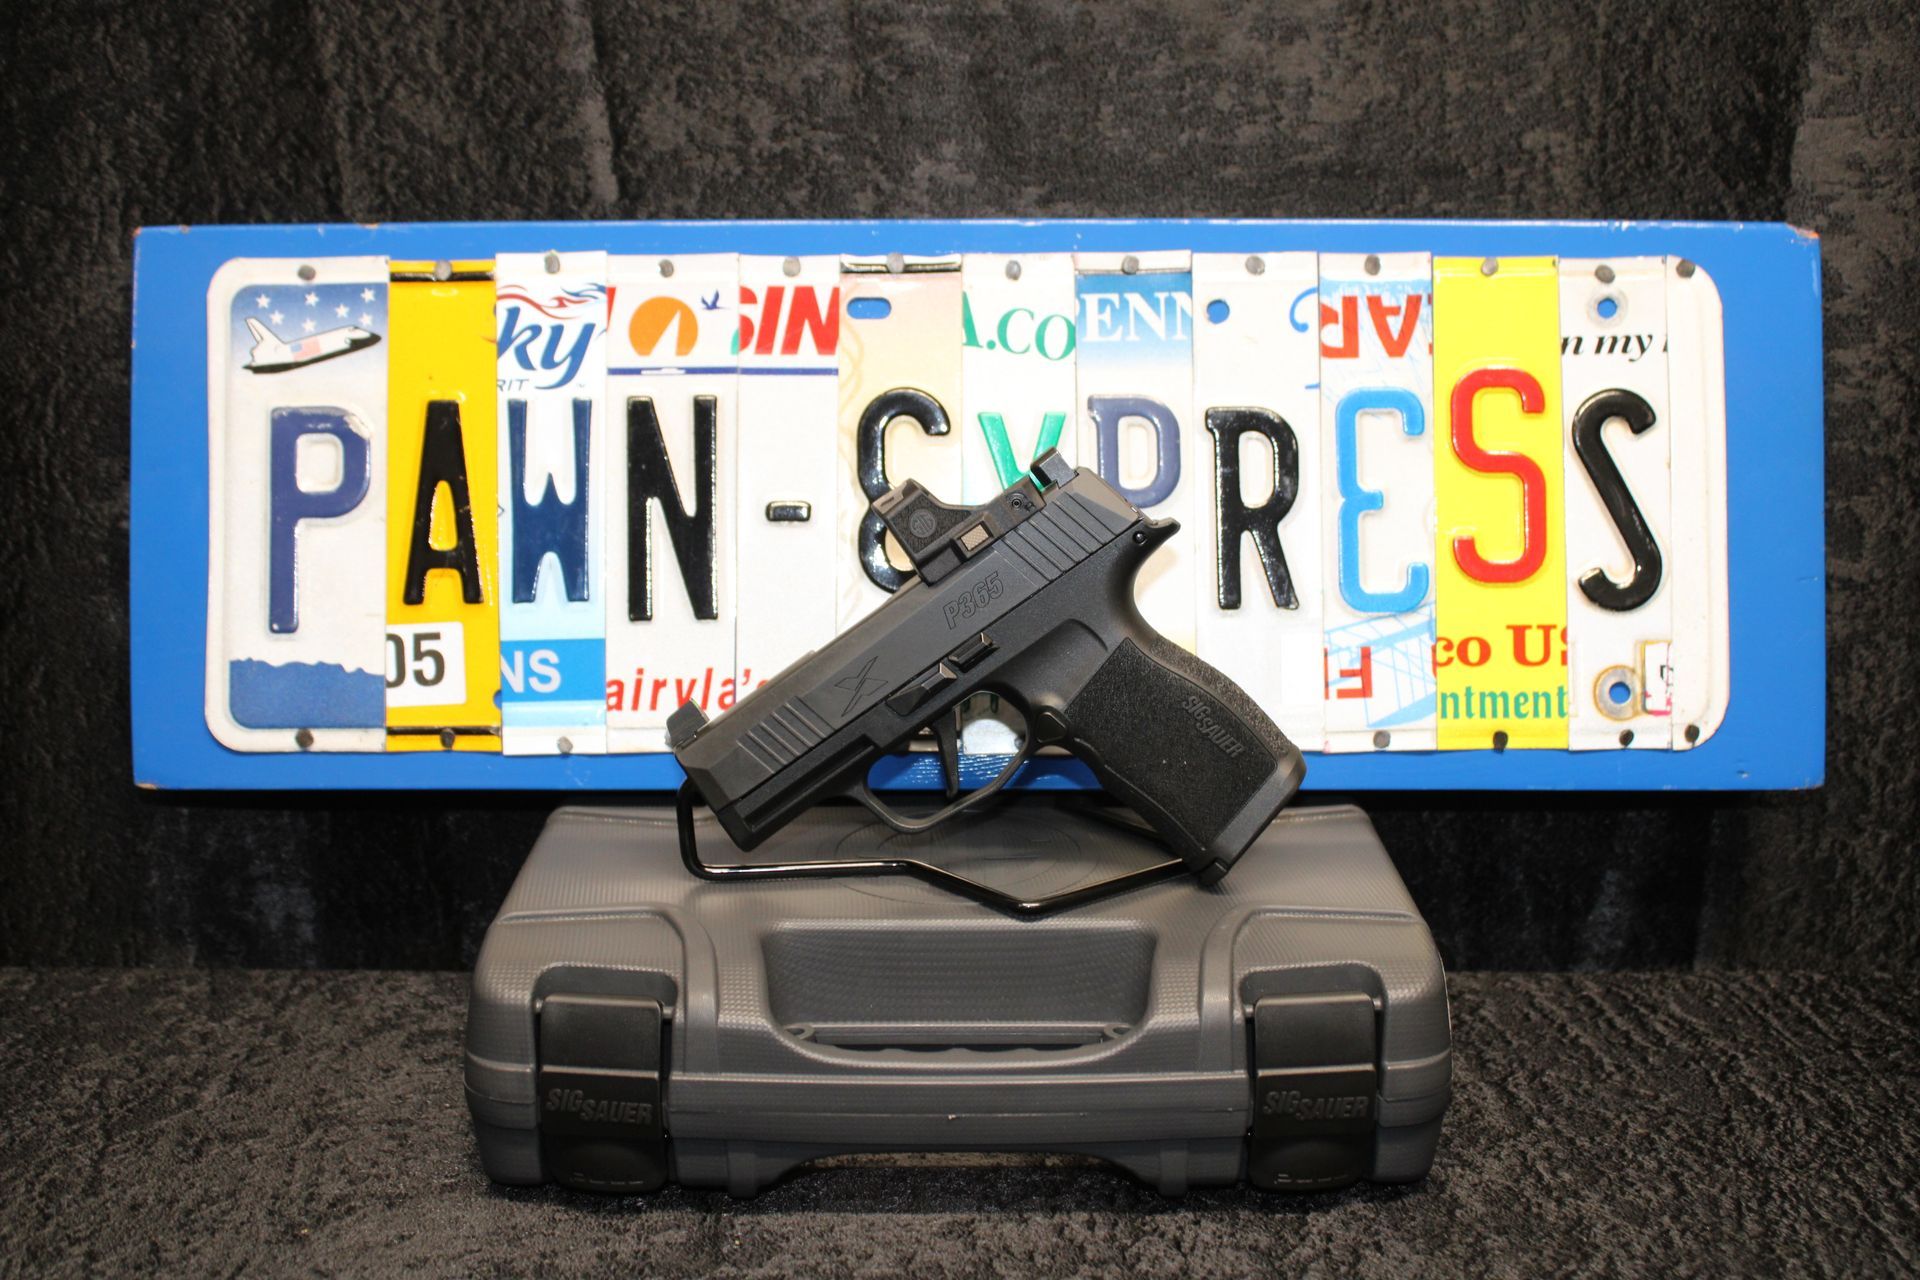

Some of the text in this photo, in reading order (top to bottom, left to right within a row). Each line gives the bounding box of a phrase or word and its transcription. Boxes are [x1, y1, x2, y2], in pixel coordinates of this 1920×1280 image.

[1594, 333, 1653, 362] my
[943, 570, 1004, 631] P365
[1505, 624, 1568, 668] U
